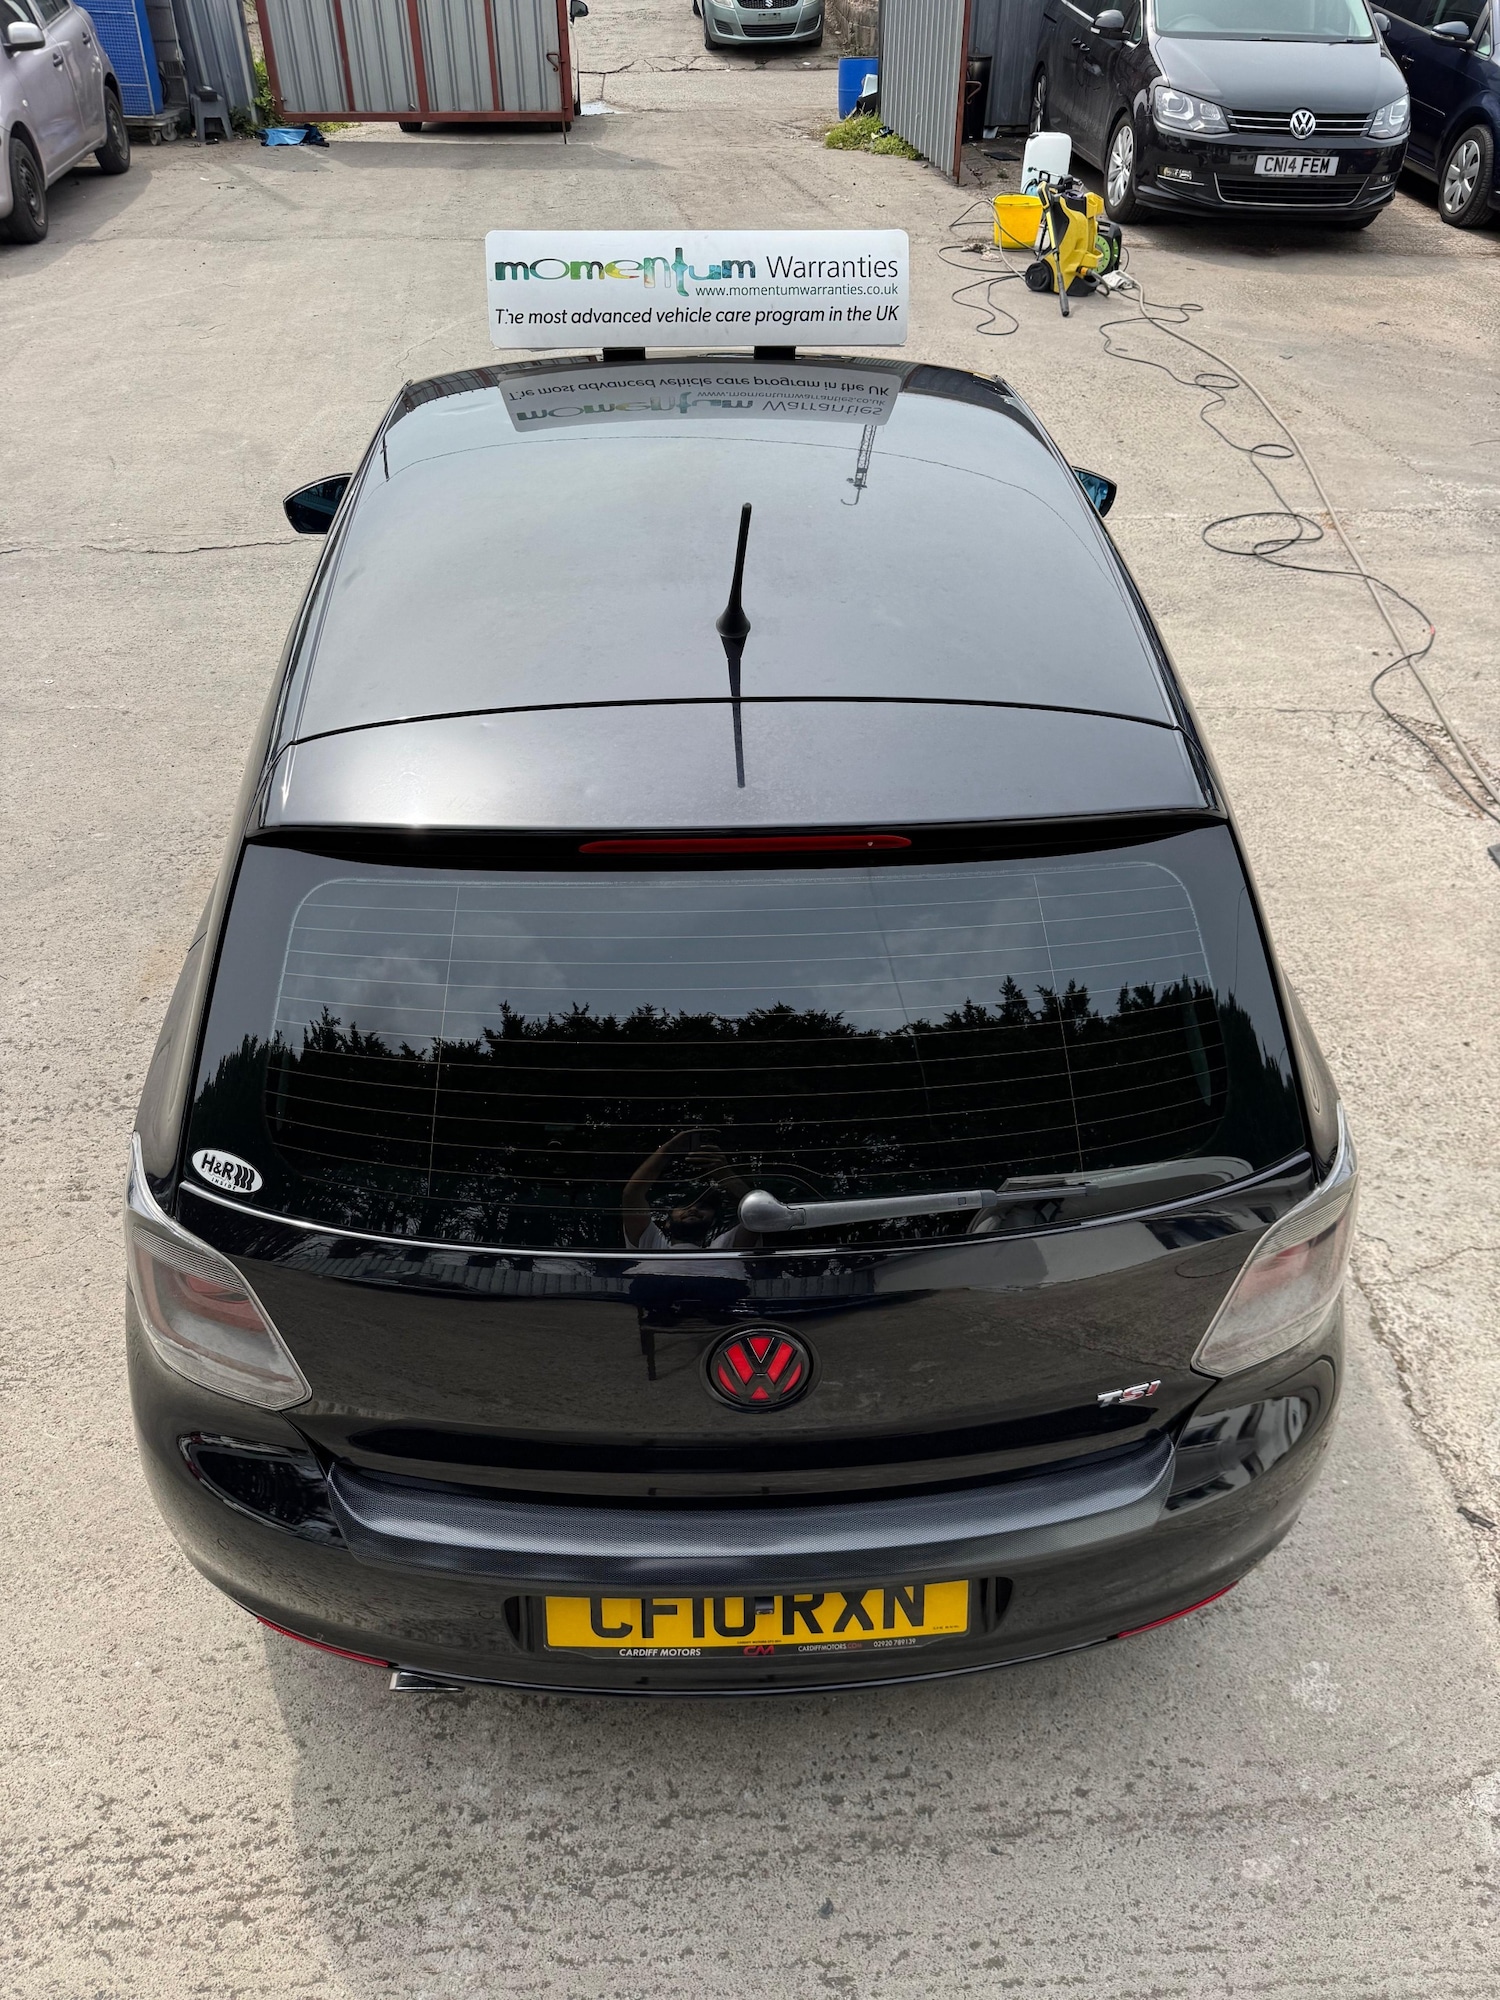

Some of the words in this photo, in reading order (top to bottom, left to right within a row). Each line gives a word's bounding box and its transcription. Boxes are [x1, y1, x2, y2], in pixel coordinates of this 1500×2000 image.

[1263, 156, 1297, 173] CN14
[1300, 157, 1331, 174] FEM
[494, 247, 756, 297] momentum
[766, 254, 899, 279] Warranties
[695, 283, 899, 297] www.momentumwarranties.co.uk
[528, 309, 568, 324] most
[571, 308, 652, 324] advanced
[656, 306, 712, 324] vehicle
[715, 310, 752, 323] care
[754, 309, 826, 326] program
[828, 305, 844, 322] in
[846, 305, 872, 322] the
[876, 305, 900, 321] UK
[201, 1152, 235, 1181] H&R
[211, 1177, 237, 1191] INSIDE
[1097, 1379, 1162, 1409] TSI
[782, 1584, 926, 1636] RXN
[618, 1647, 658, 1657] CARDIFF
[659, 1647, 702, 1657] MOTORS
[873, 1640, 893, 1648] 02920
